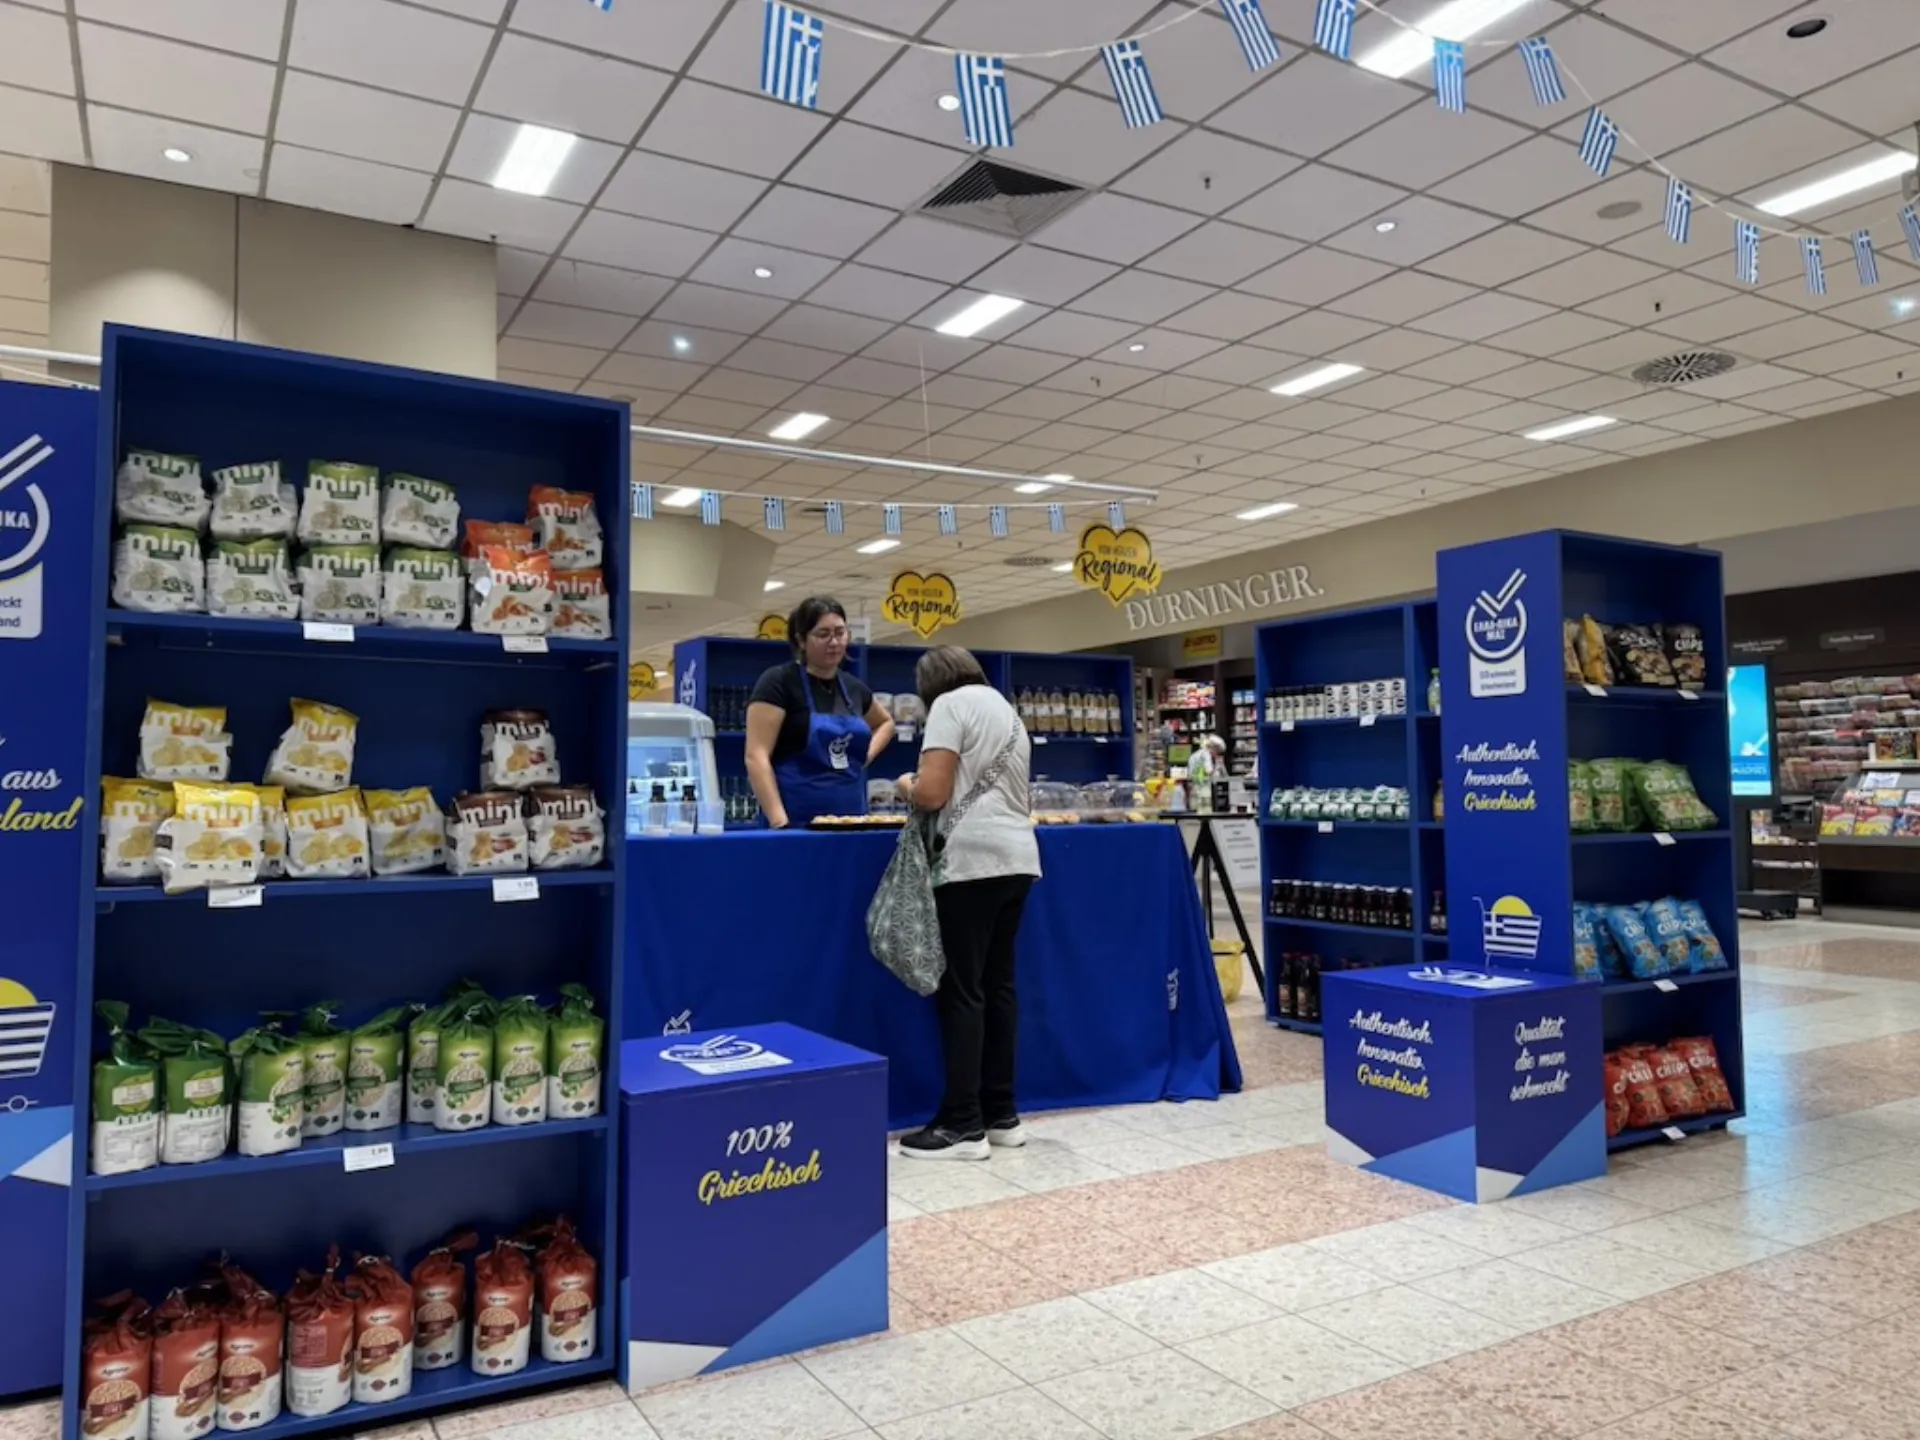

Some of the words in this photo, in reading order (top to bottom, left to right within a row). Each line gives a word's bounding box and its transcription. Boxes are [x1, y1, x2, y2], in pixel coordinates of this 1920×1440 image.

[128, 453, 200, 476] mini
[311, 474, 376, 496] mini
[394, 479, 455, 500] mini
[539, 500, 589, 520] mini
[126, 532, 199, 559] mini
[220, 547, 284, 572] mini
[312, 552, 379, 573] mini
[394, 554, 458, 577] mini
[1074, 551, 1158, 591] Regional
[886, 594, 960, 627] Regional
[1126, 565, 1326, 631] DÜRNINGER.
[152, 709, 223, 734] mini
[1, 768, 62, 790] aus
[460, 797, 522, 822] mini
[542, 790, 598, 814] mini
[1464, 789, 1537, 812] Griechisch
[290, 799, 358, 831] mini
[1514, 1046, 1535, 1072] die
[1357, 1063, 1431, 1099] Griechisch
[1509, 1069, 1571, 1102] schmeckt
[726, 1120, 794, 1157] 100%
[698, 1149, 823, 1205] Griechisch
